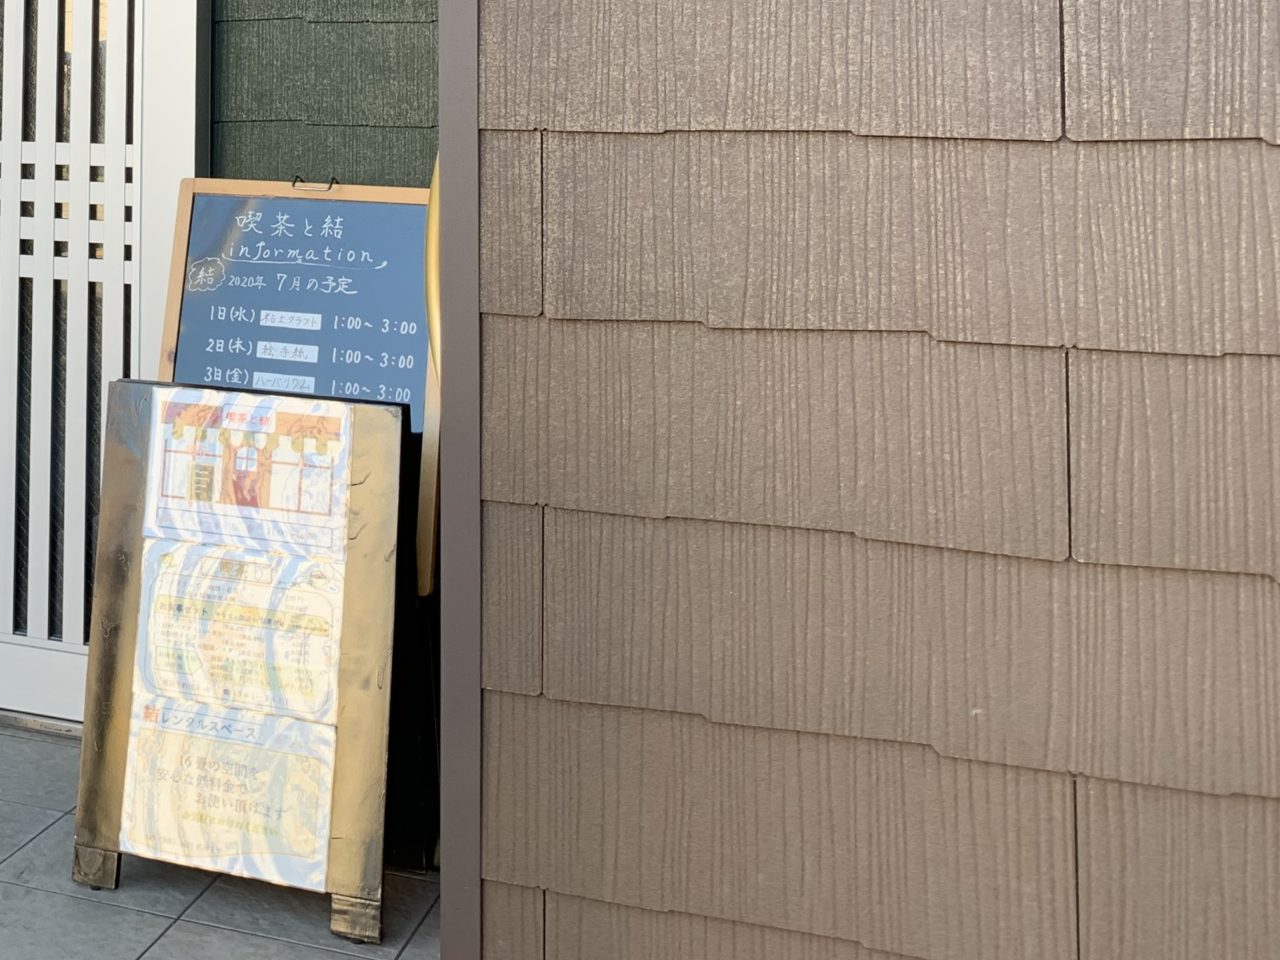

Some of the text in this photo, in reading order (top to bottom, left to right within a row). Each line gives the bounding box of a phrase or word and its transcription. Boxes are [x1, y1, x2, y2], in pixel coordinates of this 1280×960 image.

[235, 209, 345, 240] 喫茶と結
[197, 267, 216, 285] 結
[228, 272, 358, 295] 2020年 7月の予定
[161, 711, 257, 740] レンタルスペース
